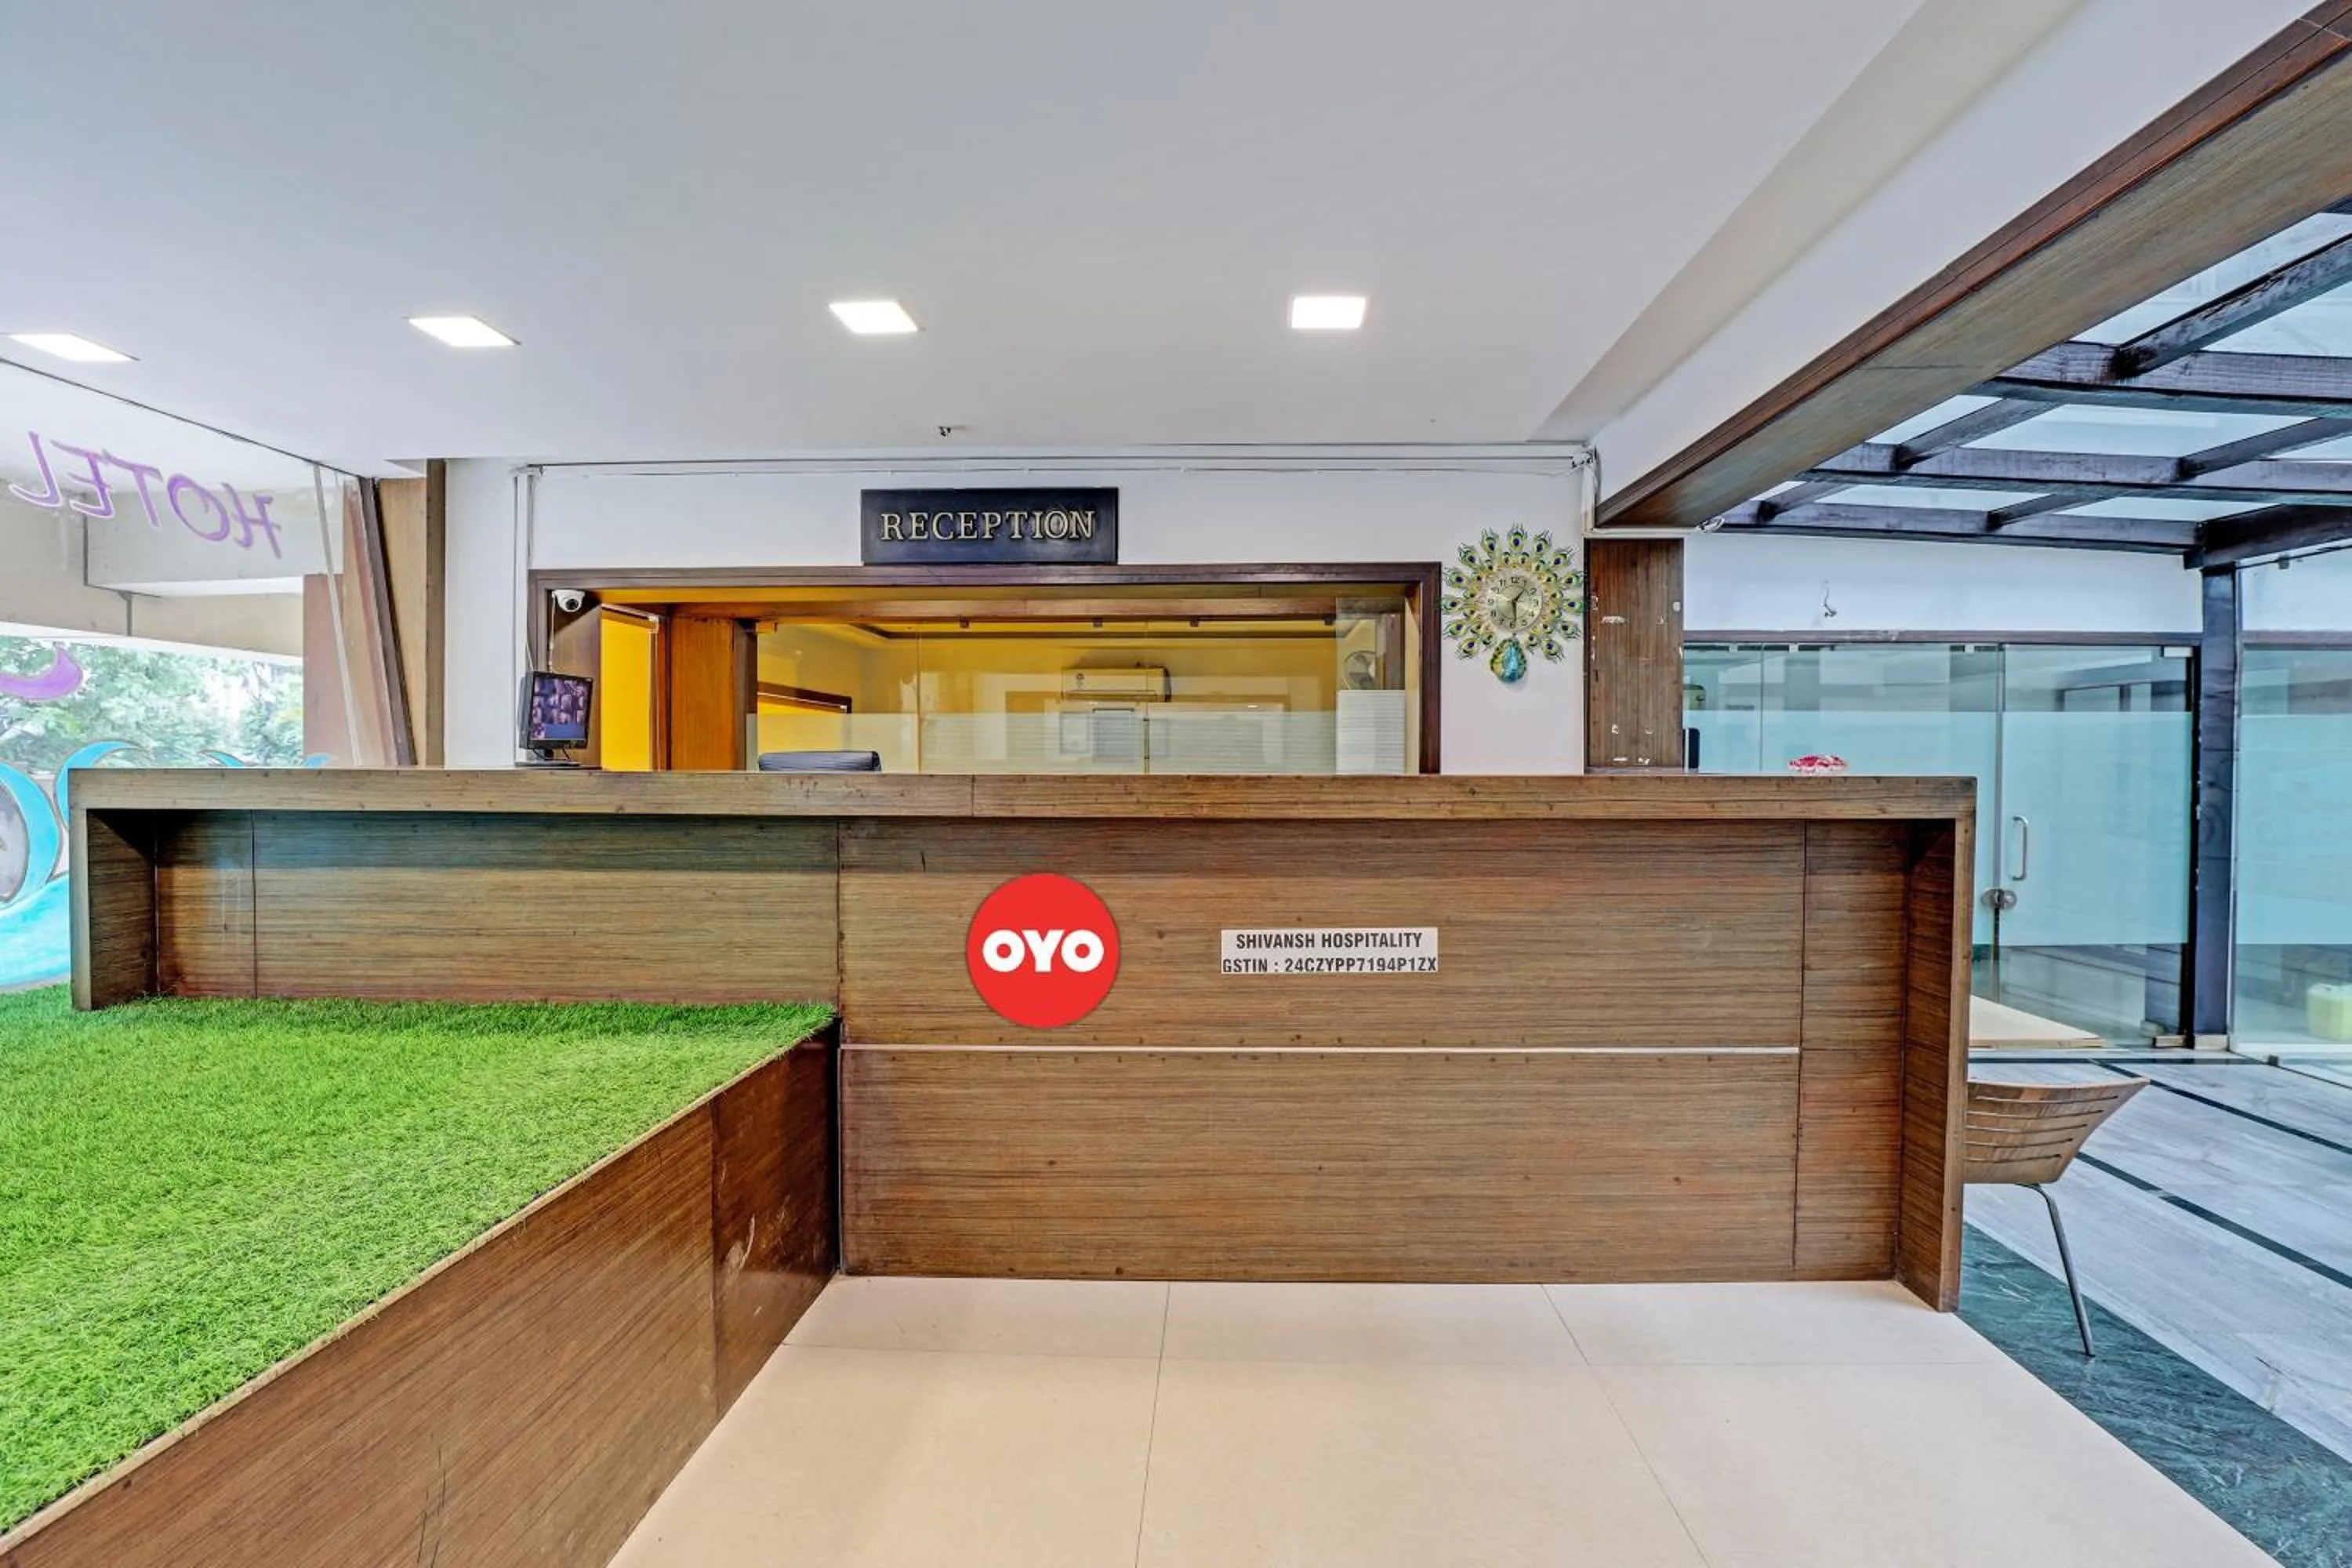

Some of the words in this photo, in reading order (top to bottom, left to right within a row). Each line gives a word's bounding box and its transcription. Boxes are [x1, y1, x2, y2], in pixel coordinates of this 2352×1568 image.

[880, 510, 1094, 540] RECEPTION
[1533, 598, 1540, 608] 3
[1509, 620, 1515, 629] 6
[1236, 934, 1315, 949] SHIVANSH
[1321, 932, 1423, 949] HOSPITALITY
[982, 929, 1105, 973] OYO
[1222, 959, 1268, 973] GSTIN
[1285, 957, 1436, 971] 24CZYPP7194P1ZX
